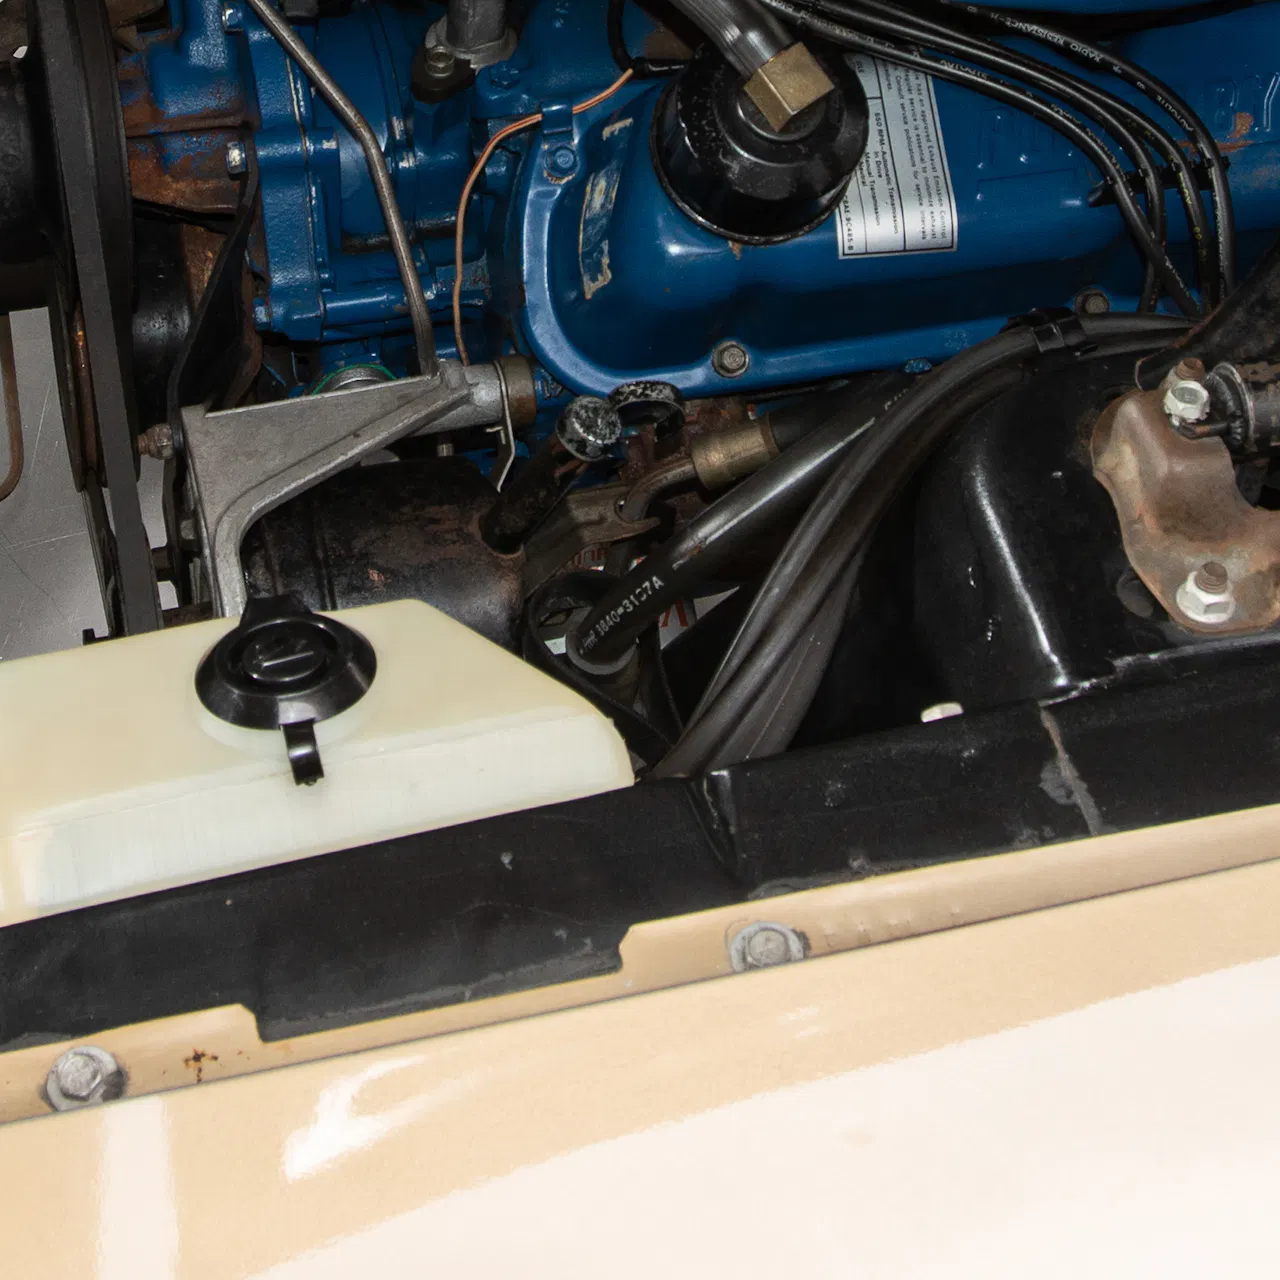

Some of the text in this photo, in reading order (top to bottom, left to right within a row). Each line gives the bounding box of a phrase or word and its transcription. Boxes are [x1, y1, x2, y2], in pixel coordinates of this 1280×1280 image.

[895, 75, 905, 99] Consult
[899, 102, 908, 125] service
[918, 98, 924, 107] an
[919, 109, 932, 142] approved
[903, 128, 917, 167] publications
[927, 145, 938, 173] Exhaust
[858, 161, 867, 187] Neutral
[874, 112, 882, 127] 550
[888, 187, 899, 234] Transmission
[875, 160, 883, 178] Drive
[908, 97, 917, 122] service
[915, 133, 926, 164] essential
[923, 176, 934, 207] minimize
[929, 210, 937, 239] exhaust
[863, 151, 880, 225] Manual Transmission
[914, 183, 923, 206] service
[933, 175, 944, 207] Emission
[919, 210, 928, 240] intervals
[939, 210, 948, 238] Control
